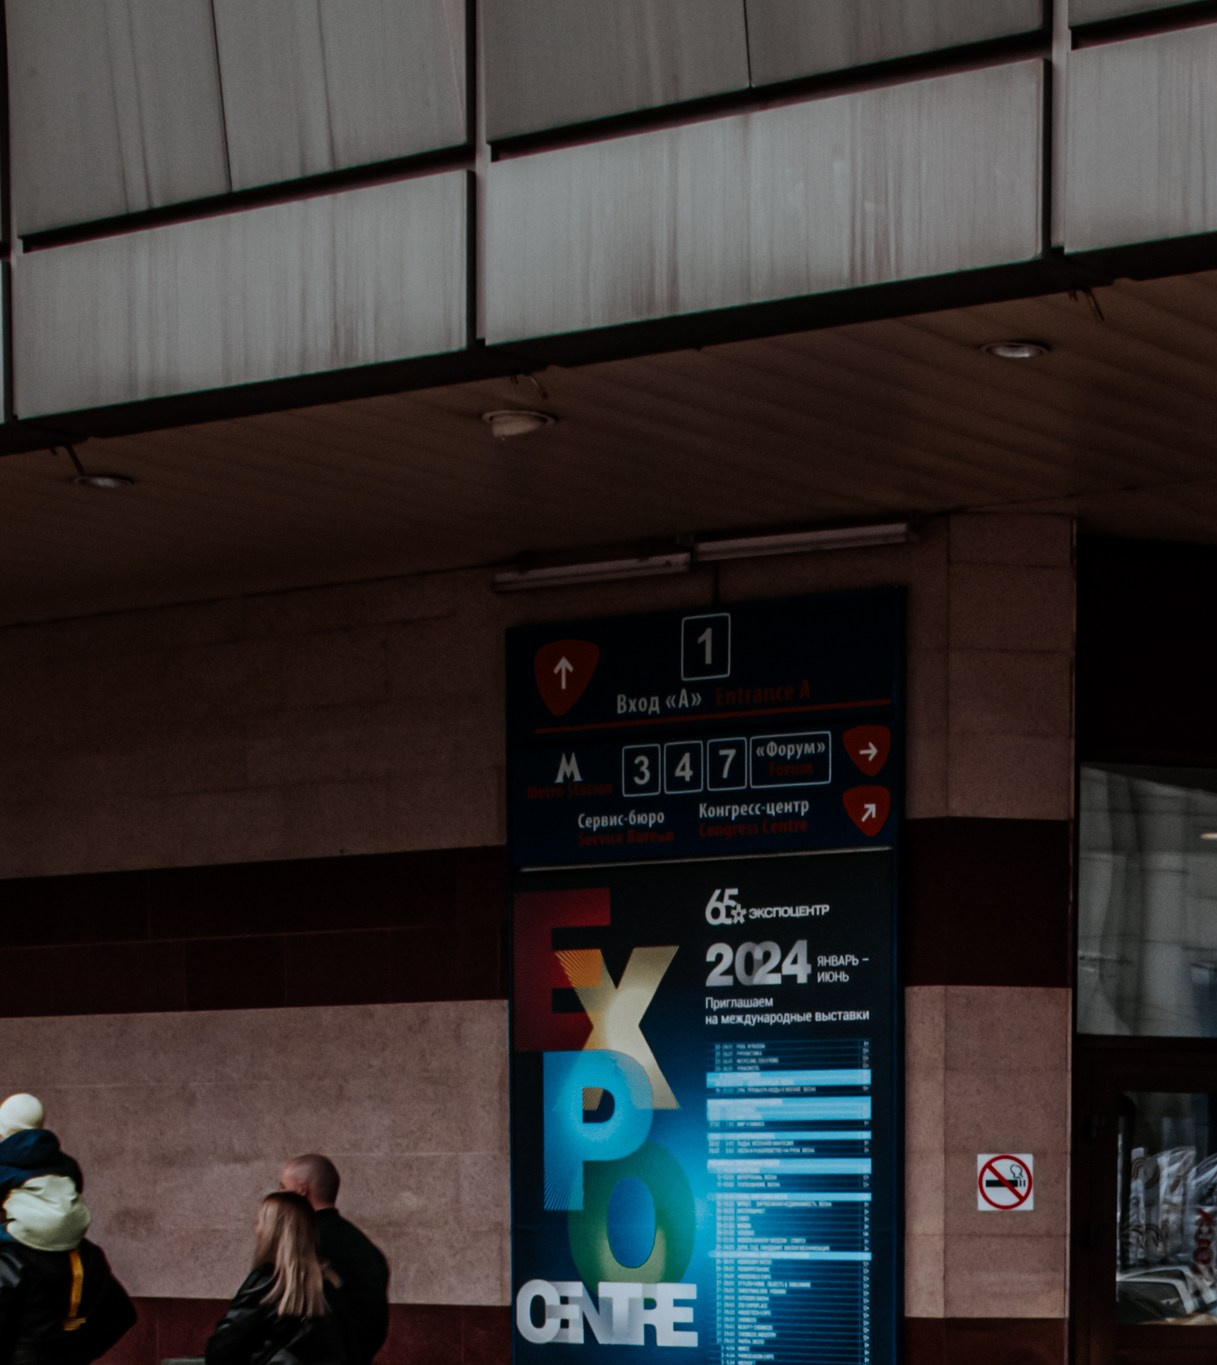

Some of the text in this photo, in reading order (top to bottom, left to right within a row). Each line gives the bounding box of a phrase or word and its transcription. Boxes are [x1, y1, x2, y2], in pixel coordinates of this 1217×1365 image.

[697, 627, 713, 665] 1
[616, 691, 660, 715] Вход
[716, 683, 794, 705] Entrance
[756, 739, 826, 759] «Форум»
[633, 748, 736, 786] 3 4 7
[768, 760, 814, 777] Forum
[527, 782, 613, 800] Metro Station
[699, 799, 810, 821] Конгресс-центр
[577, 809, 665, 832] Сервис-бюро
[698, 817, 809, 839] Congress Centre
[577, 827, 675, 847] Service Bureau
[748, 904, 830, 920] ЭКСПОЦЕНТР
[705, 939, 812, 988] 2024
[817, 954, 859, 967] ЯНВАРЬ
[817, 971, 850, 983] ИЮНЬ
[705, 996, 774, 1011] Приглашаем
[705, 1010, 870, 1027] на международные выставки
